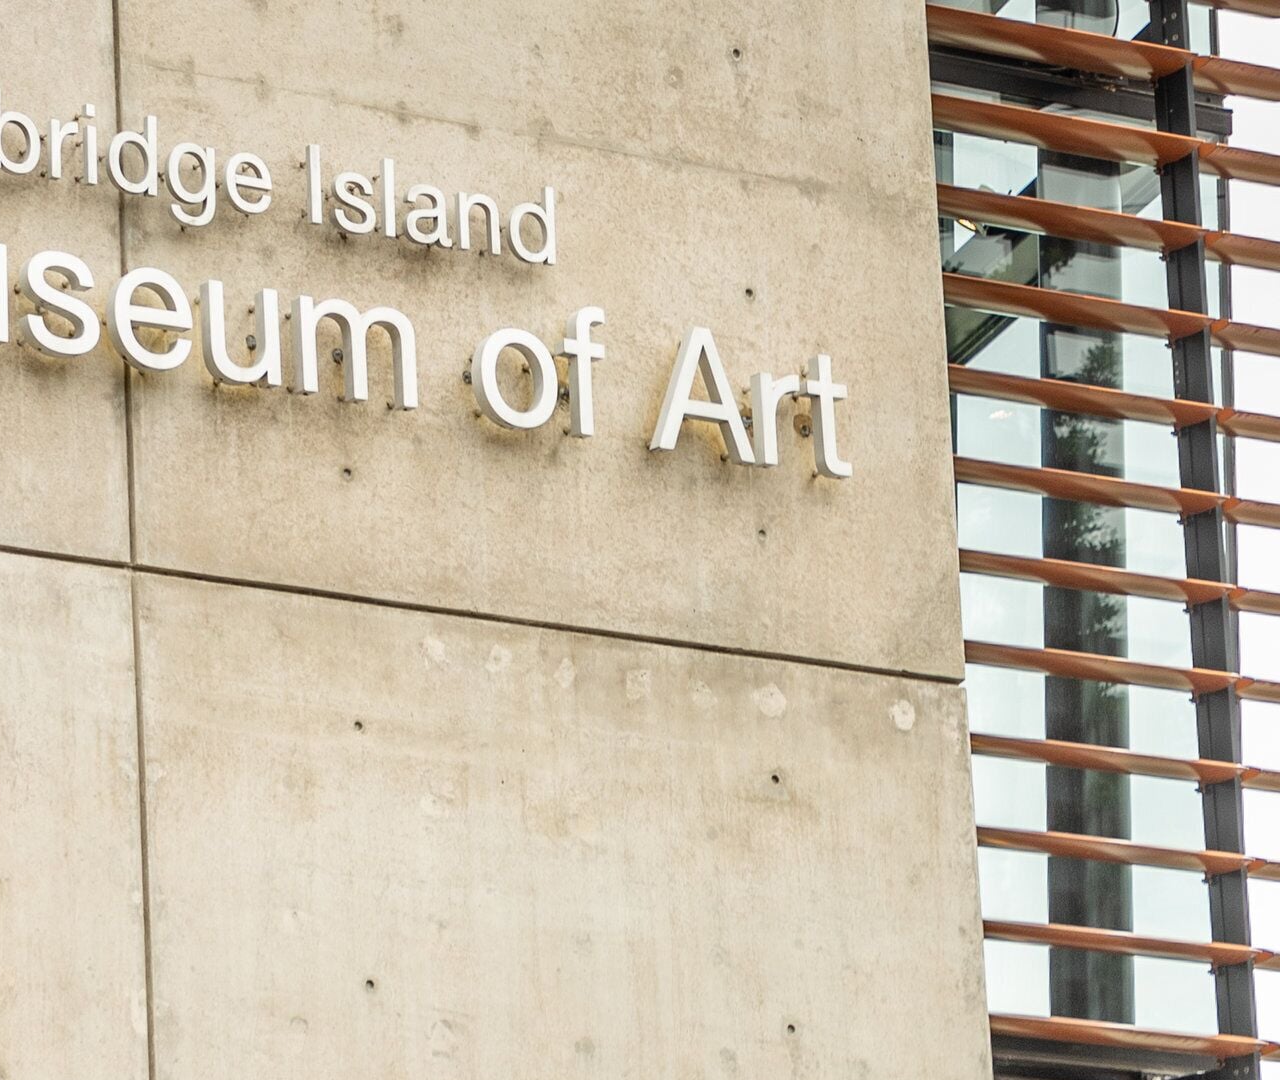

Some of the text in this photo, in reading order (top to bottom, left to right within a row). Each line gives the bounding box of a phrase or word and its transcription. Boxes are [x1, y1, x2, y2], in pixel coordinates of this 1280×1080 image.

[306, 143, 557, 266] Island
[471, 306, 605, 438] of
[649, 325, 853, 479] Art
